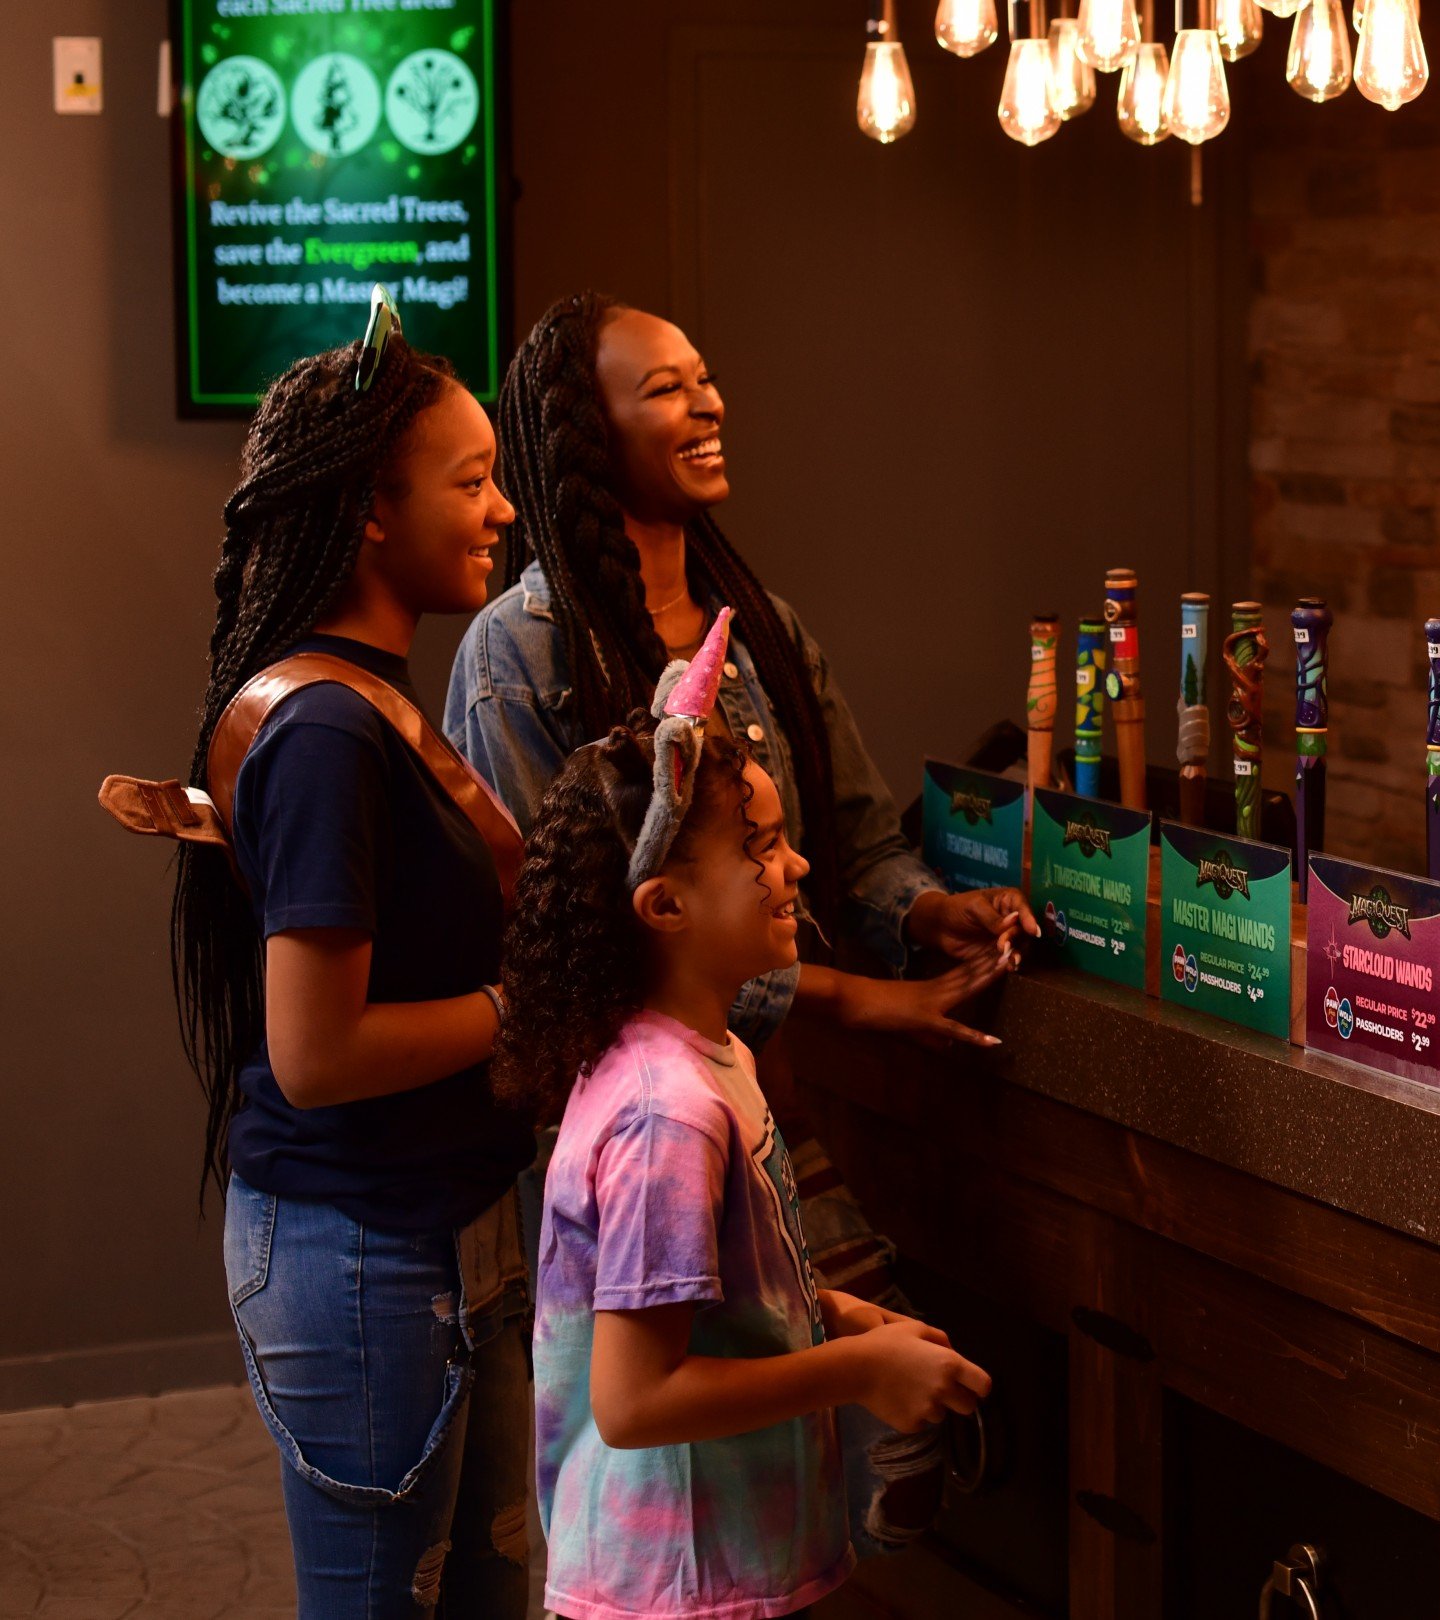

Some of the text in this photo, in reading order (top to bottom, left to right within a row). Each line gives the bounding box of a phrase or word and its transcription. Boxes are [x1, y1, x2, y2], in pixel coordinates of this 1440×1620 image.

[211, 195, 469, 226] Revive the Sacred Trees,
[215, 245, 262, 265] save
[265, 236, 303, 264] the
[425, 234, 470, 262] and
[217, 277, 302, 304] become
[304, 283, 319, 304] a
[322, 277, 399, 304] Masr
[1103, 878, 1131, 906] WANDS
[1173, 898, 1275, 951] MASTER MAGI WANDS
[1200, 952, 1226, 969] REGULAR
[1227, 960, 1244, 974] PRICE
[1342, 944, 1432, 992] STARCLOUD WANDS
[1200, 972, 1241, 994] PASSHOLDERS
[1355, 995, 1387, 1014] REGULAR
[1387, 1005, 1408, 1022] PRICE
[1356, 1017, 1404, 1042] PASSHOLDERS
